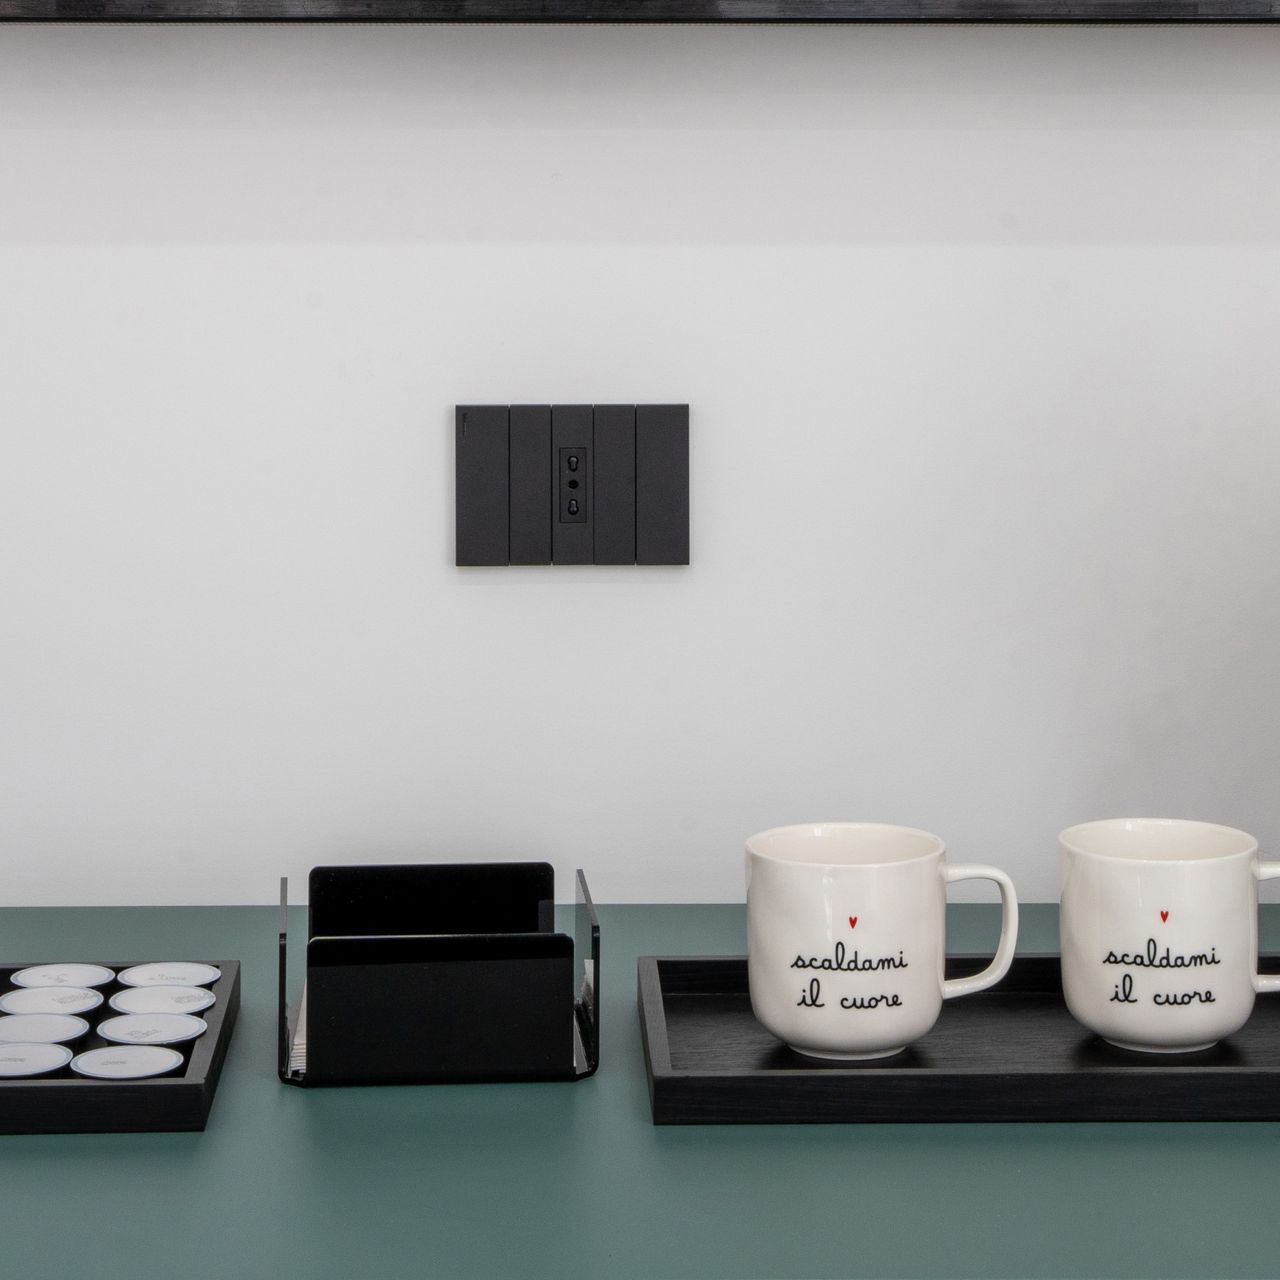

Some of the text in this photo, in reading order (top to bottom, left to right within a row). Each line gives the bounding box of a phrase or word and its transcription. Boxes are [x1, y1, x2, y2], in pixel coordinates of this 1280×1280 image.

[790, 941, 909, 972] scaldami
[1102, 938, 1221, 969] scaldami
[796, 977, 903, 1010] il cuore
[1109, 973, 1216, 1006] il cuore
